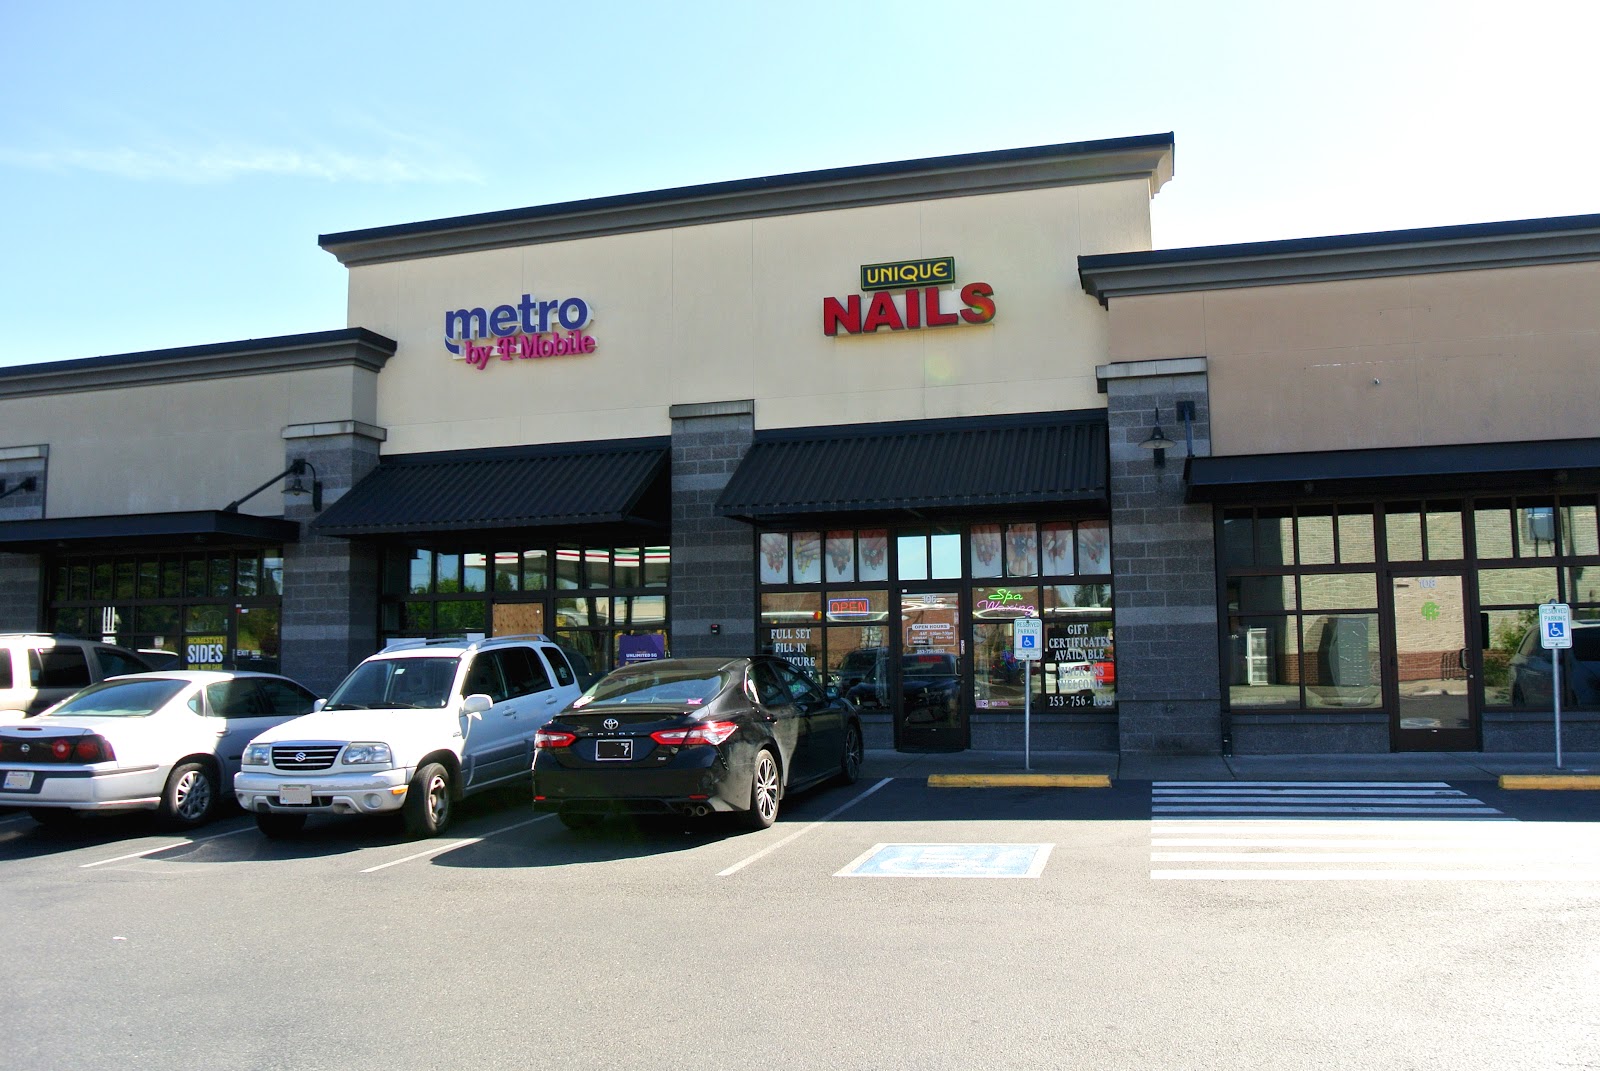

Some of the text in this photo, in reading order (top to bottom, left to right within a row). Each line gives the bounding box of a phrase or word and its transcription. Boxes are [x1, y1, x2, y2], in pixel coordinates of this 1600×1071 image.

[867, 261, 948, 284] UNIQUE
[824, 282, 996, 337] NAILS
[445, 294, 589, 340] metro
[465, 340, 494, 370] by
[988, 588, 1023, 604] Spa
[831, 601, 867, 614] OPEN
[977, 600, 1035, 617] Waxing
[770, 628, 812, 640] FULL SET
[1067, 624, 1089, 635] GIFT
[187, 636, 224, 644] HOMESTYLE
[1049, 636, 1111, 648] CERTIFICATES
[187, 644, 223, 663] SIDES
[775, 642, 807, 653] FILL IN
[1055, 648, 1105, 660] AVAILABLE
[1057, 679, 1104, 691] WELCOME
